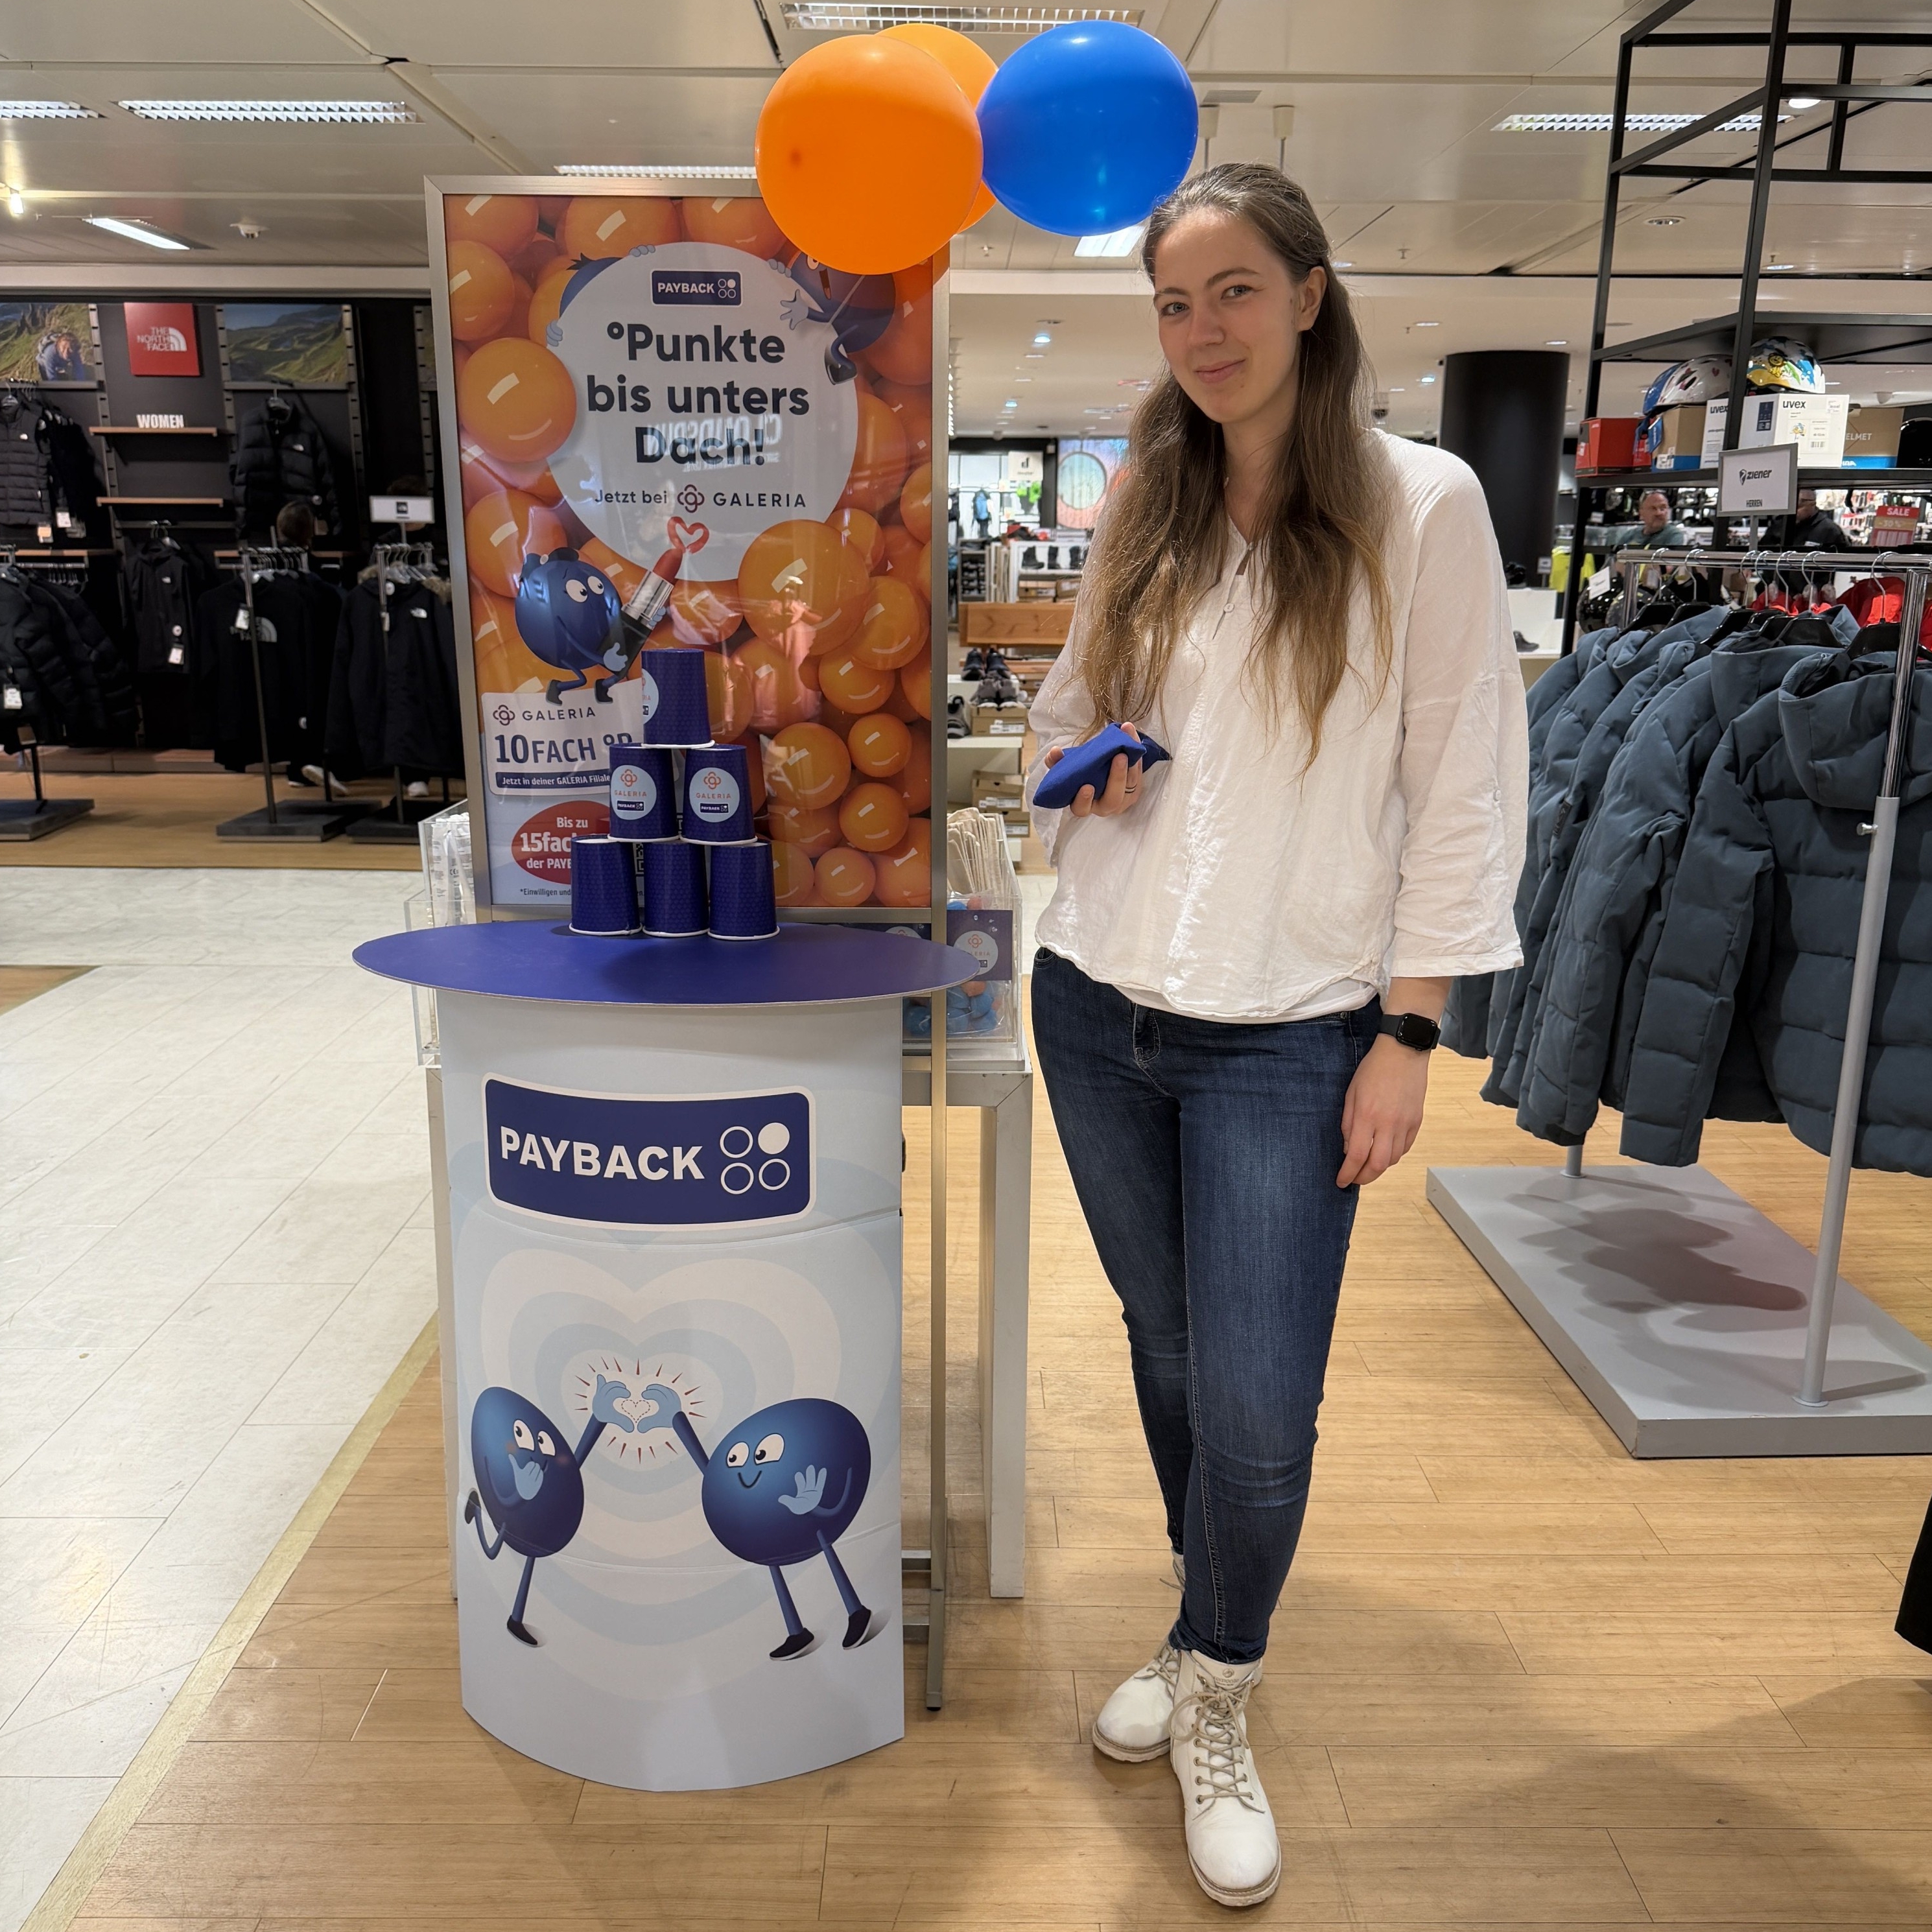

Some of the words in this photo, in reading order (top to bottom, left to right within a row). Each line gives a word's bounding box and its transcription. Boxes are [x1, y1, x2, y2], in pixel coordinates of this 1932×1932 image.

[657, 282, 715, 294] PAYBACK
[150, 327, 169, 335] THE
[587, 374, 651, 412] bis
[667, 381, 810, 416] unters
[1782, 400, 1806, 409] uvex
[136, 414, 184, 429] WOMEN
[635, 425, 765, 466] Dach!
[595, 489, 636, 504] Jetzt
[642, 490, 668, 504] bei
[713, 492, 807, 508] GALERIA
[1746, 499, 1763, 508] HERREN
[1887, 508, 1910, 517] SALE
[522, 707, 596, 721] GALERIA
[532, 776, 555, 785] deiner
[556, 775, 588, 784] GALERIA
[557, 817, 573, 828] Bis
[576, 819, 588, 828] zu
[520, 832, 577, 853] 15fac
[526, 858, 543, 869] der
[501, 1125, 705, 1181] PAYBACK
